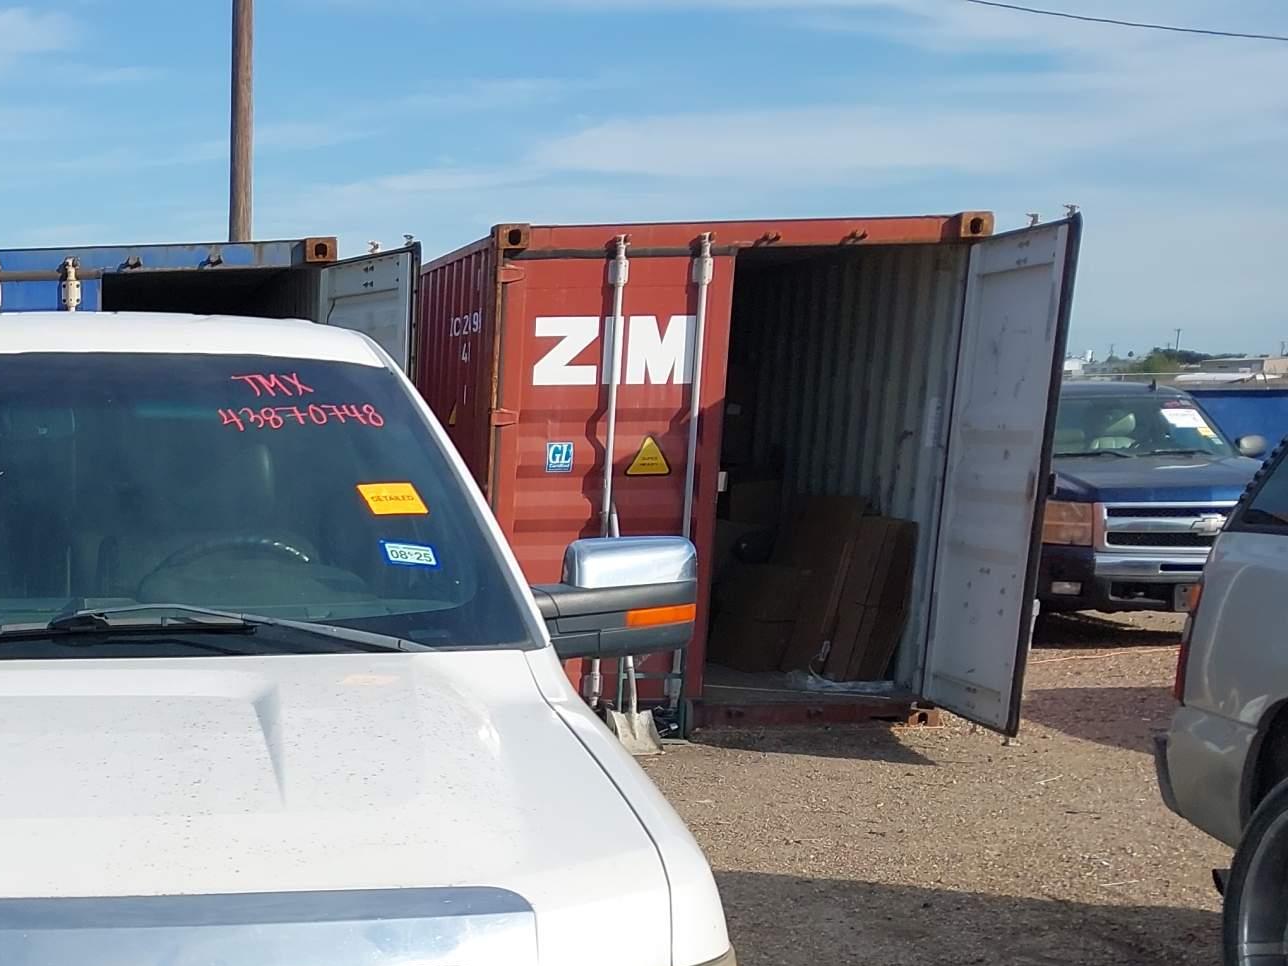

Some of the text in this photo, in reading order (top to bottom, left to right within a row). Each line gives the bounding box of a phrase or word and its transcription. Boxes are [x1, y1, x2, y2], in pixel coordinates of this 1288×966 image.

[532, 315, 696, 386] ZIM
[231, 372, 314, 397] TMX
[218, 403, 384, 432] 43870748
[549, 444, 572, 463] GL
